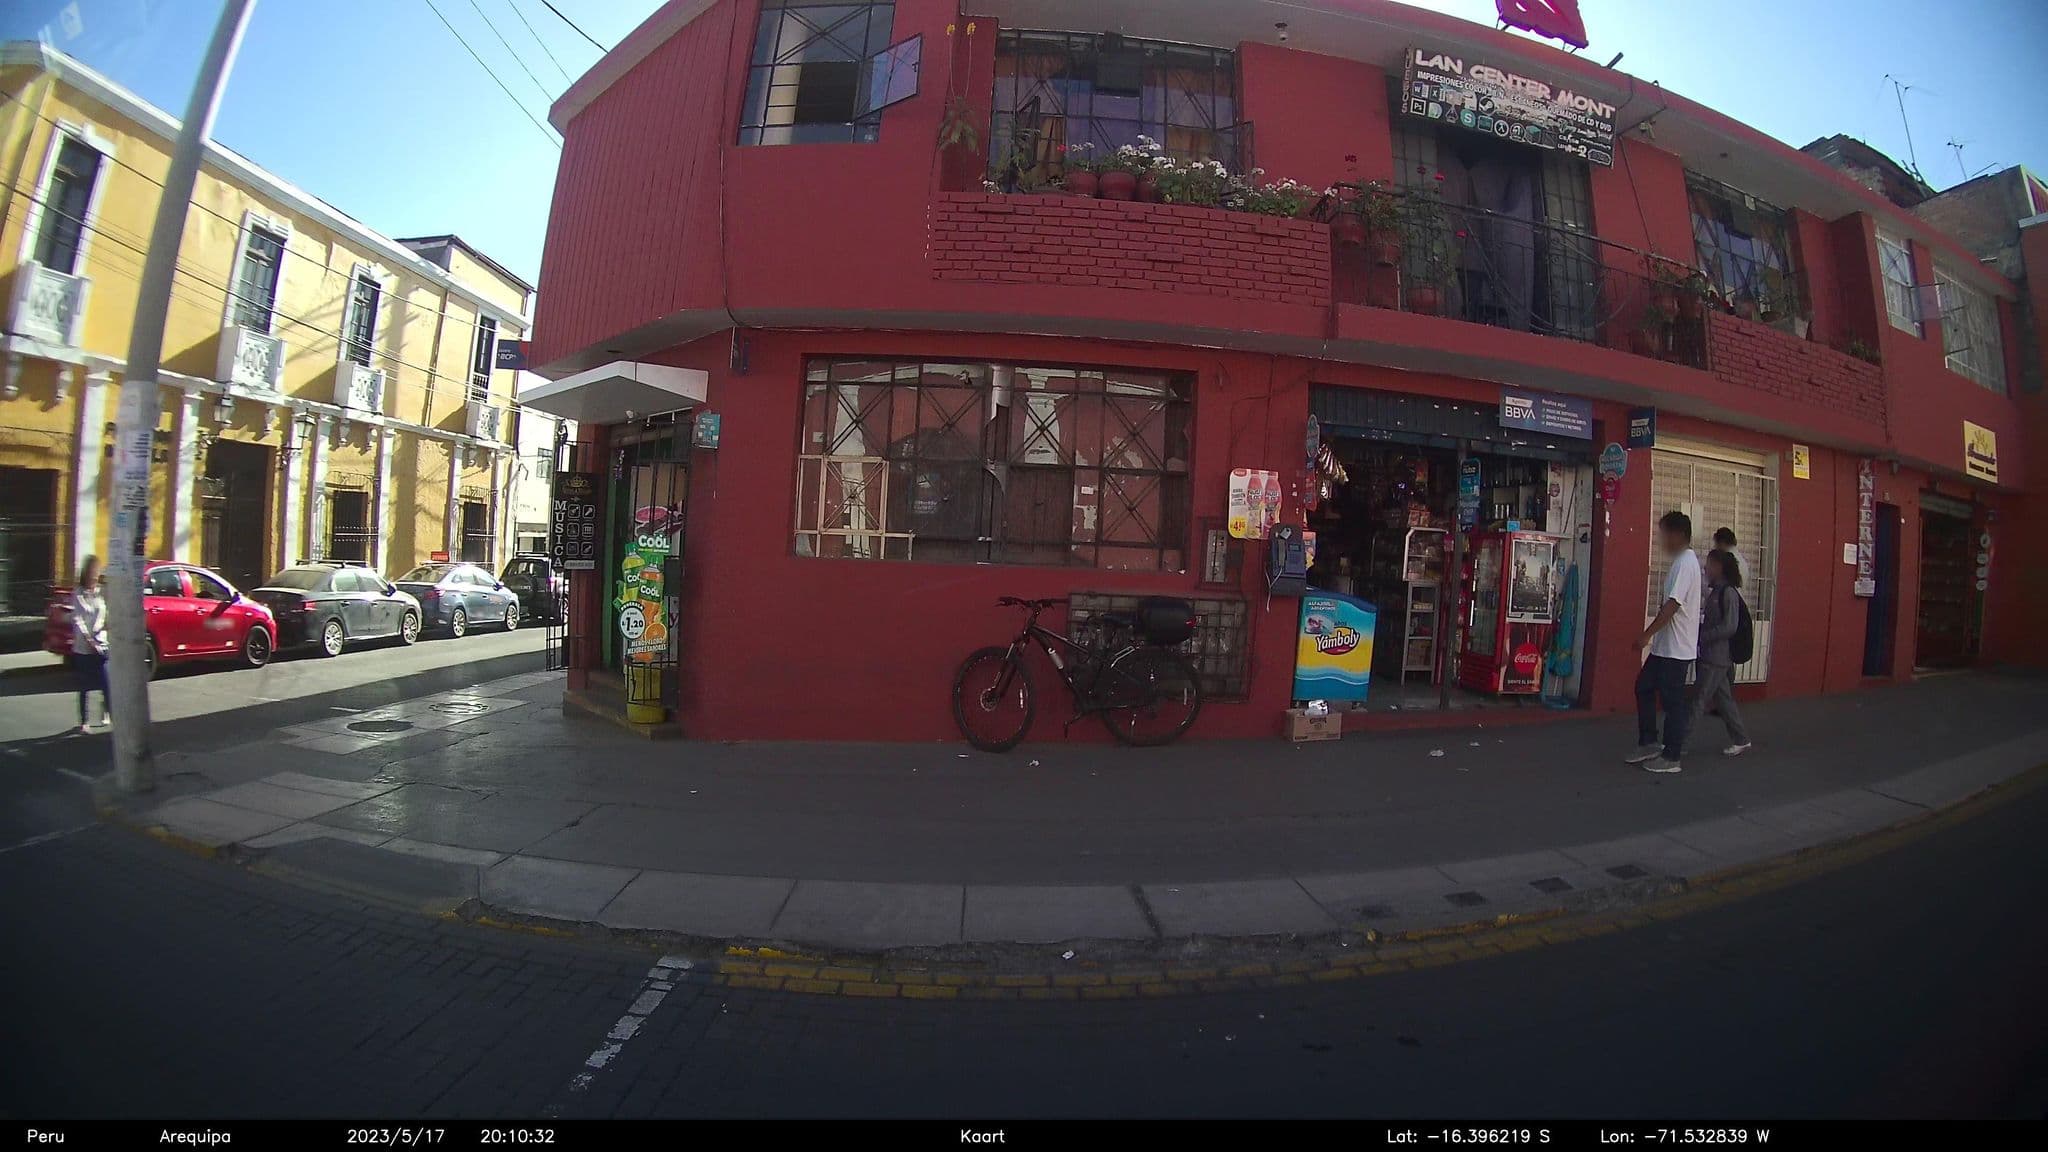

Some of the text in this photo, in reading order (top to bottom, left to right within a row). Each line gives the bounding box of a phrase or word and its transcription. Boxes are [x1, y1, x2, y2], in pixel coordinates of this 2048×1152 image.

[1415, 49, 1463, 75] LAN
[1470, 64, 1551, 101] CENTER
[1557, 88, 1616, 119] MONT
[1417, 70, 1464, 89] IMPRESIONES
[1505, 405, 1536, 420] BBVA
[1631, 425, 1652, 439] BBVA
[1858, 457, 1874, 582] INTERNE
